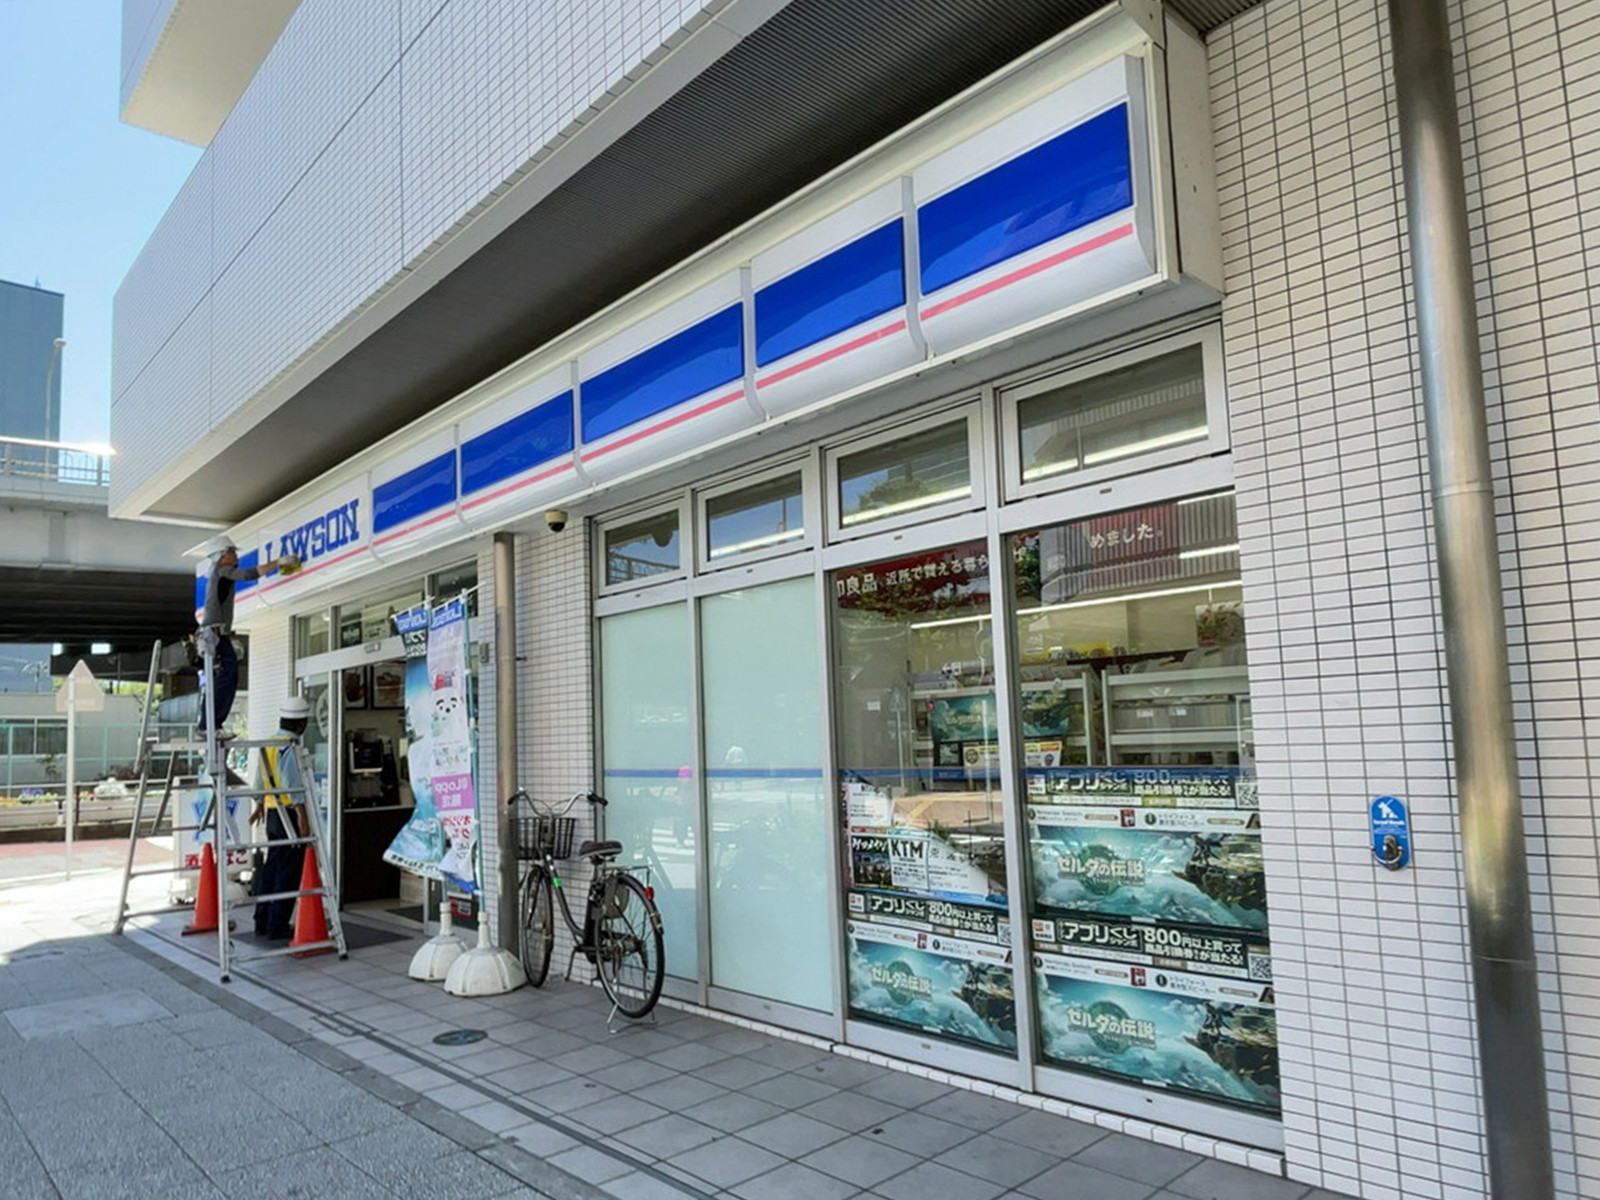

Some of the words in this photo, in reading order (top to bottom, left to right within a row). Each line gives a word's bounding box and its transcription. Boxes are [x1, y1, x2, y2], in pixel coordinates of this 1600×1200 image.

[265, 498, 359, 577] LAWSON
[891, 839, 924, 859] KTM
[1057, 855, 1144, 878] ゼルダの伝説
[1067, 1006, 1155, 1041] ゼルダの伝説
